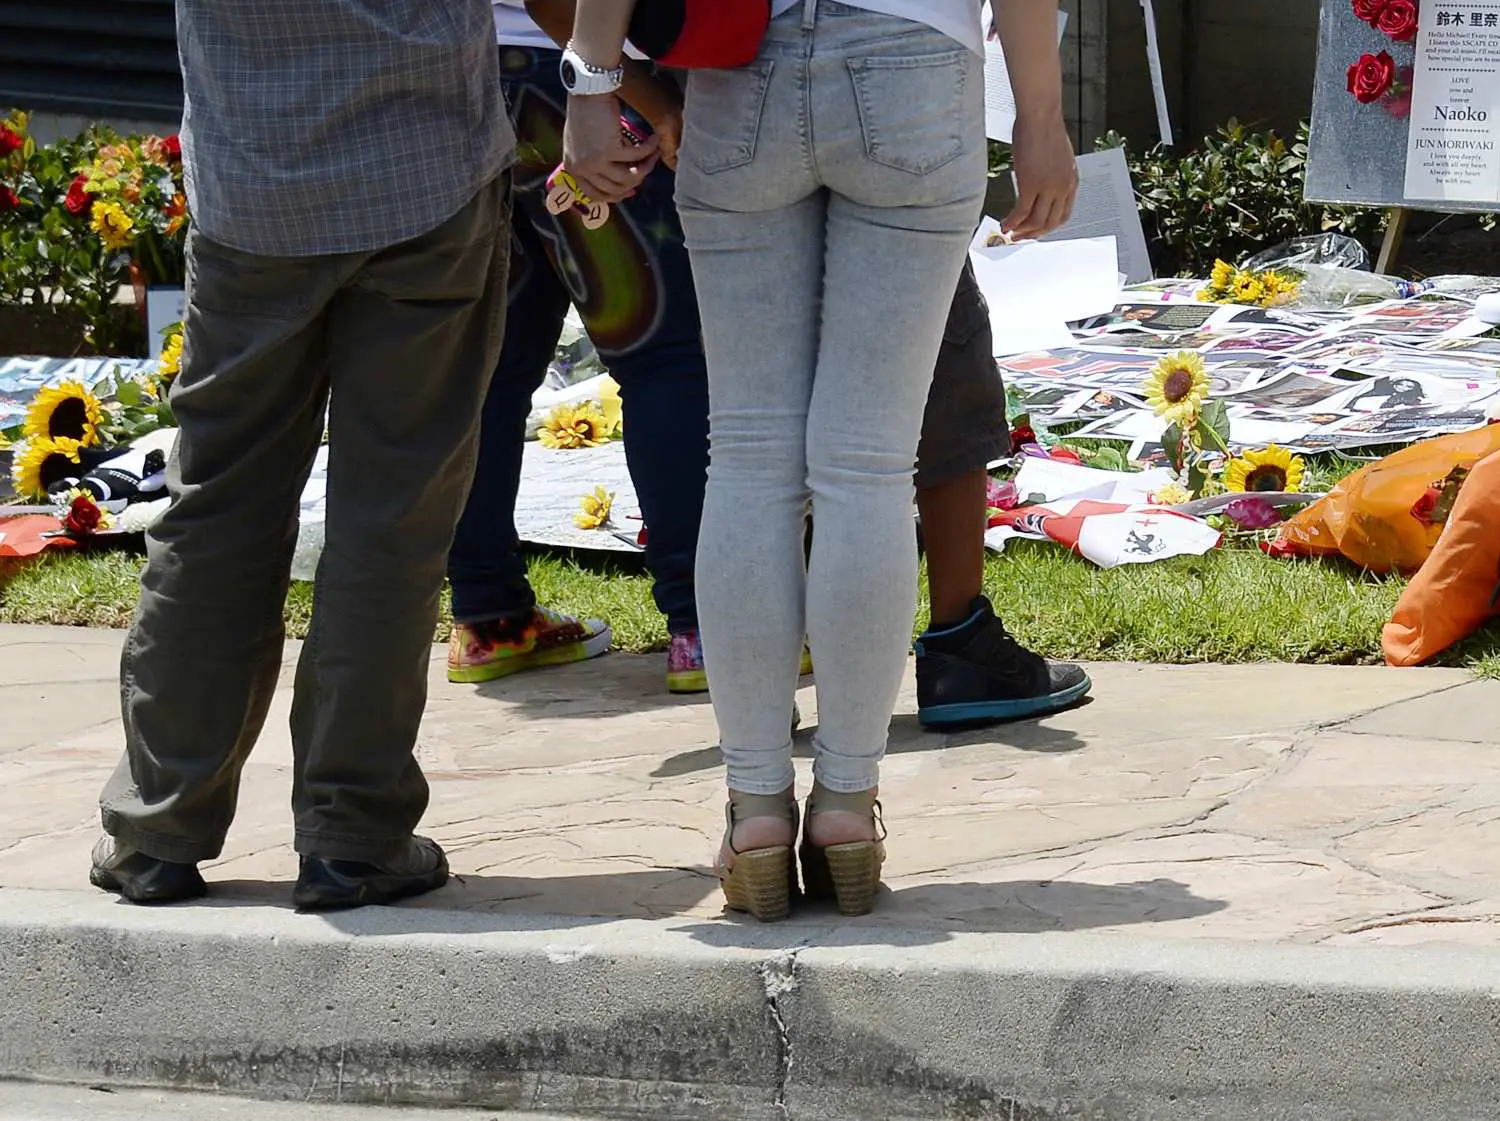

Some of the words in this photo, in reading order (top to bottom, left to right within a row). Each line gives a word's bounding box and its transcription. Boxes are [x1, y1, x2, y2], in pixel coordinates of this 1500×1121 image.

[1436, 12, 1465, 26] 鈴木
[1469, 12, 1498, 27] 里奈
[1434, 105, 1487, 121] Naoko
[1416, 139, 1435, 150] JUN
[1437, 140, 1494, 150] MORIWAKI
